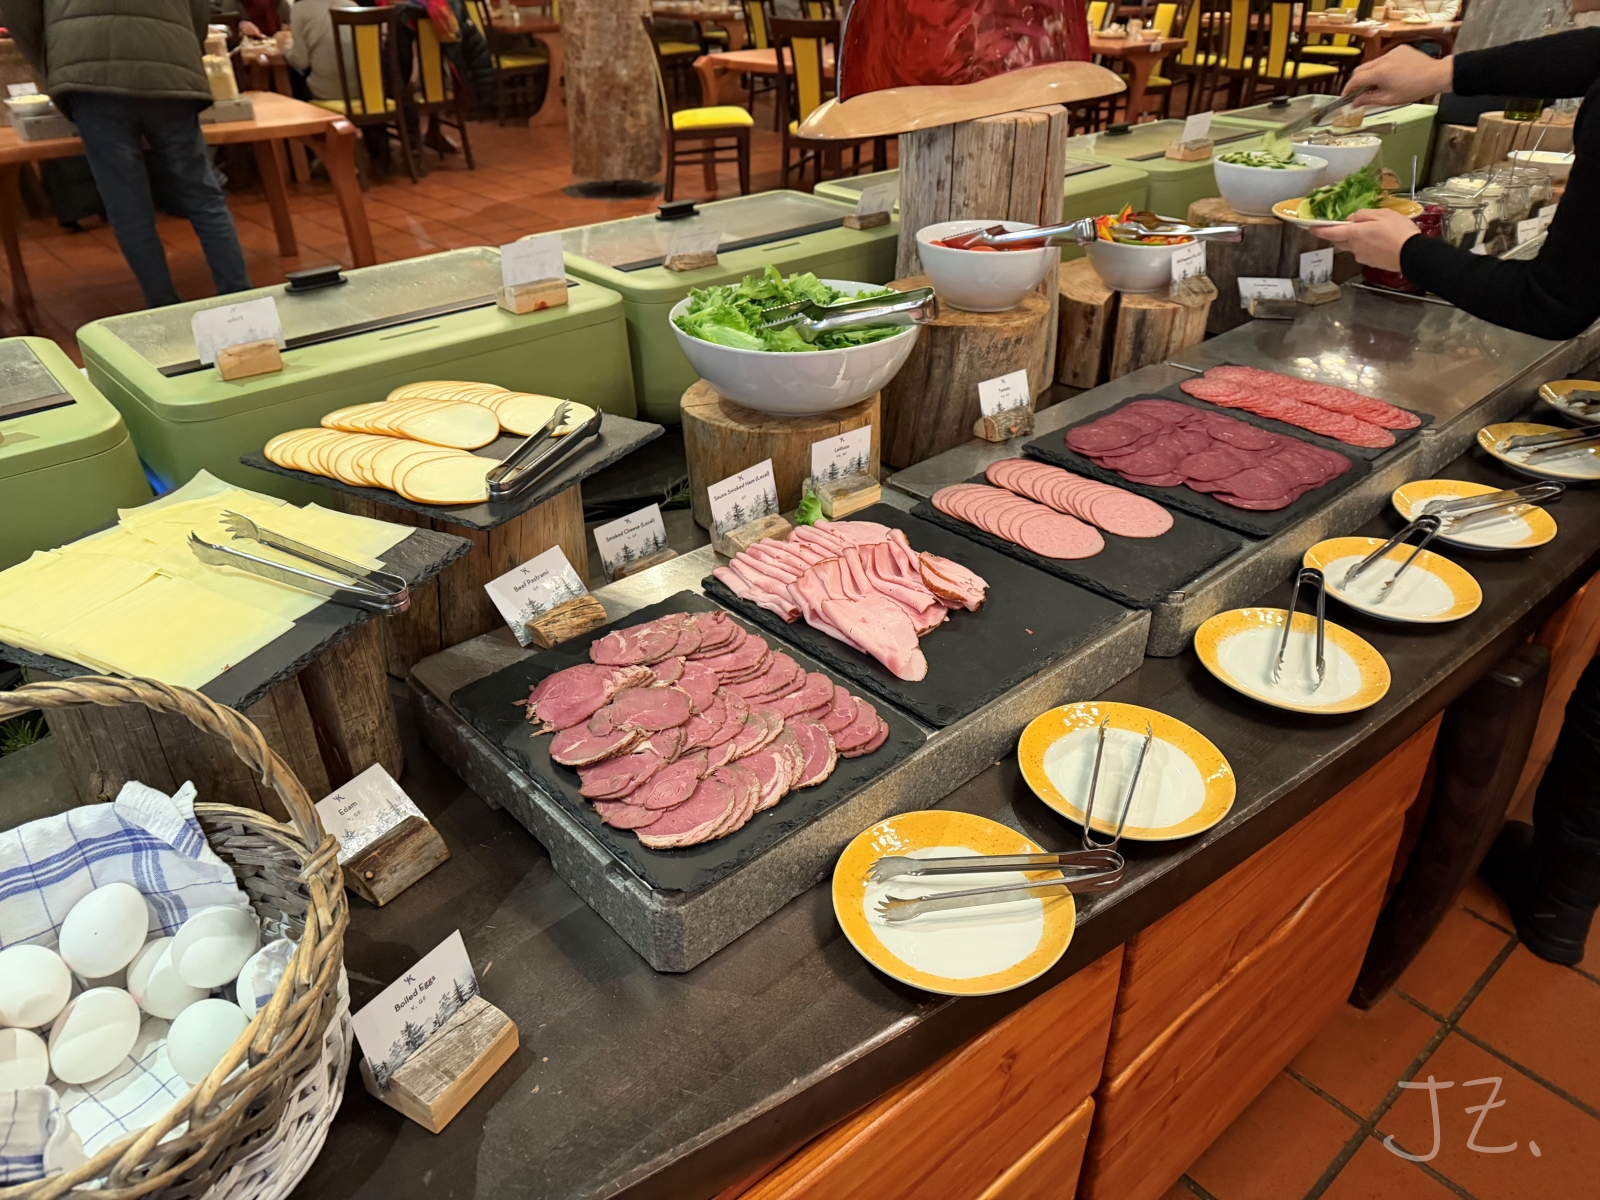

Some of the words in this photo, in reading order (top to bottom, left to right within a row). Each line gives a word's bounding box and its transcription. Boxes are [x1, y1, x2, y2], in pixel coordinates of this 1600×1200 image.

[834, 444, 850, 453] Lettuce
[713, 491, 728, 502] Sauna
[727, 482, 745, 495] Smoked
[745, 478, 756, 487] Ham
[755, 470, 770, 483] (Local)
[605, 530, 624, 543] Smoked
[623, 525, 640, 535] Cheese
[640, 517, 656, 528] (Local)
[513, 581, 527, 593] Beef
[526, 569, 550, 585] Pastrami
[337, 801, 358, 816] Edam
[353, 809, 361, 817] GF
[394, 988, 419, 1012] Boiled
[418, 975, 436, 992] Eggs
[418, 995, 426, 1004] GF
